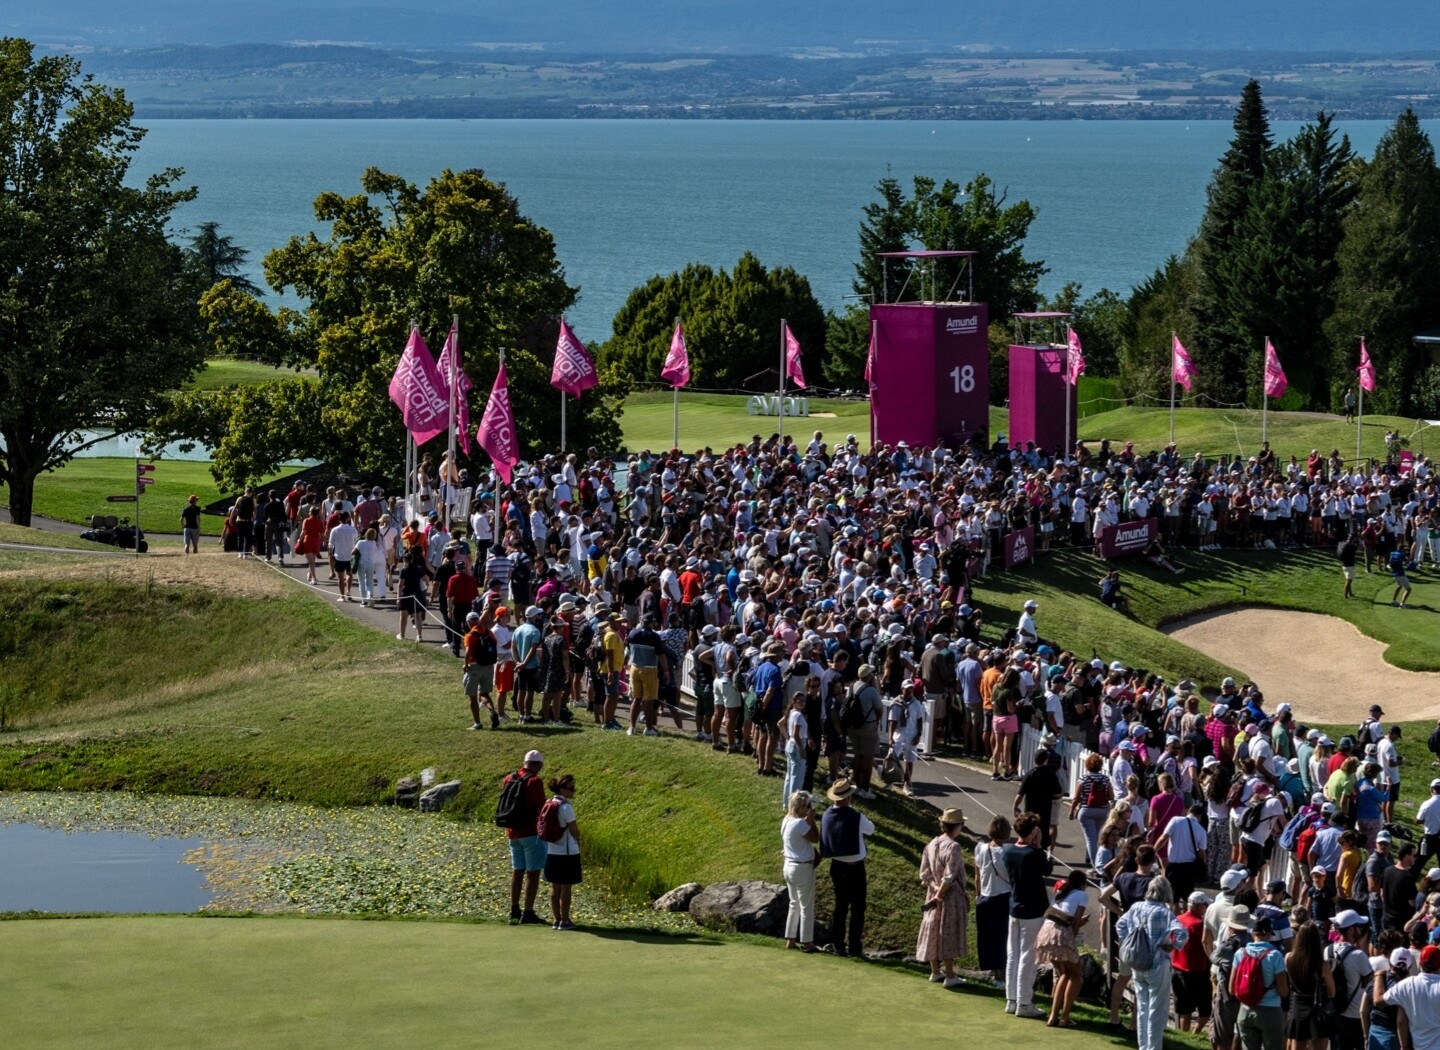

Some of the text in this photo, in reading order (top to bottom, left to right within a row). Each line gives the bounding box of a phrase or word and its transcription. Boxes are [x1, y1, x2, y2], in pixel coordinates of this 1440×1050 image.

[946, 316, 977, 327] Amundi
[410, 356, 449, 414] Amundi
[950, 365, 975, 393] 18
[747, 394, 809, 417] evian
[1115, 524, 1149, 542] Amundi
